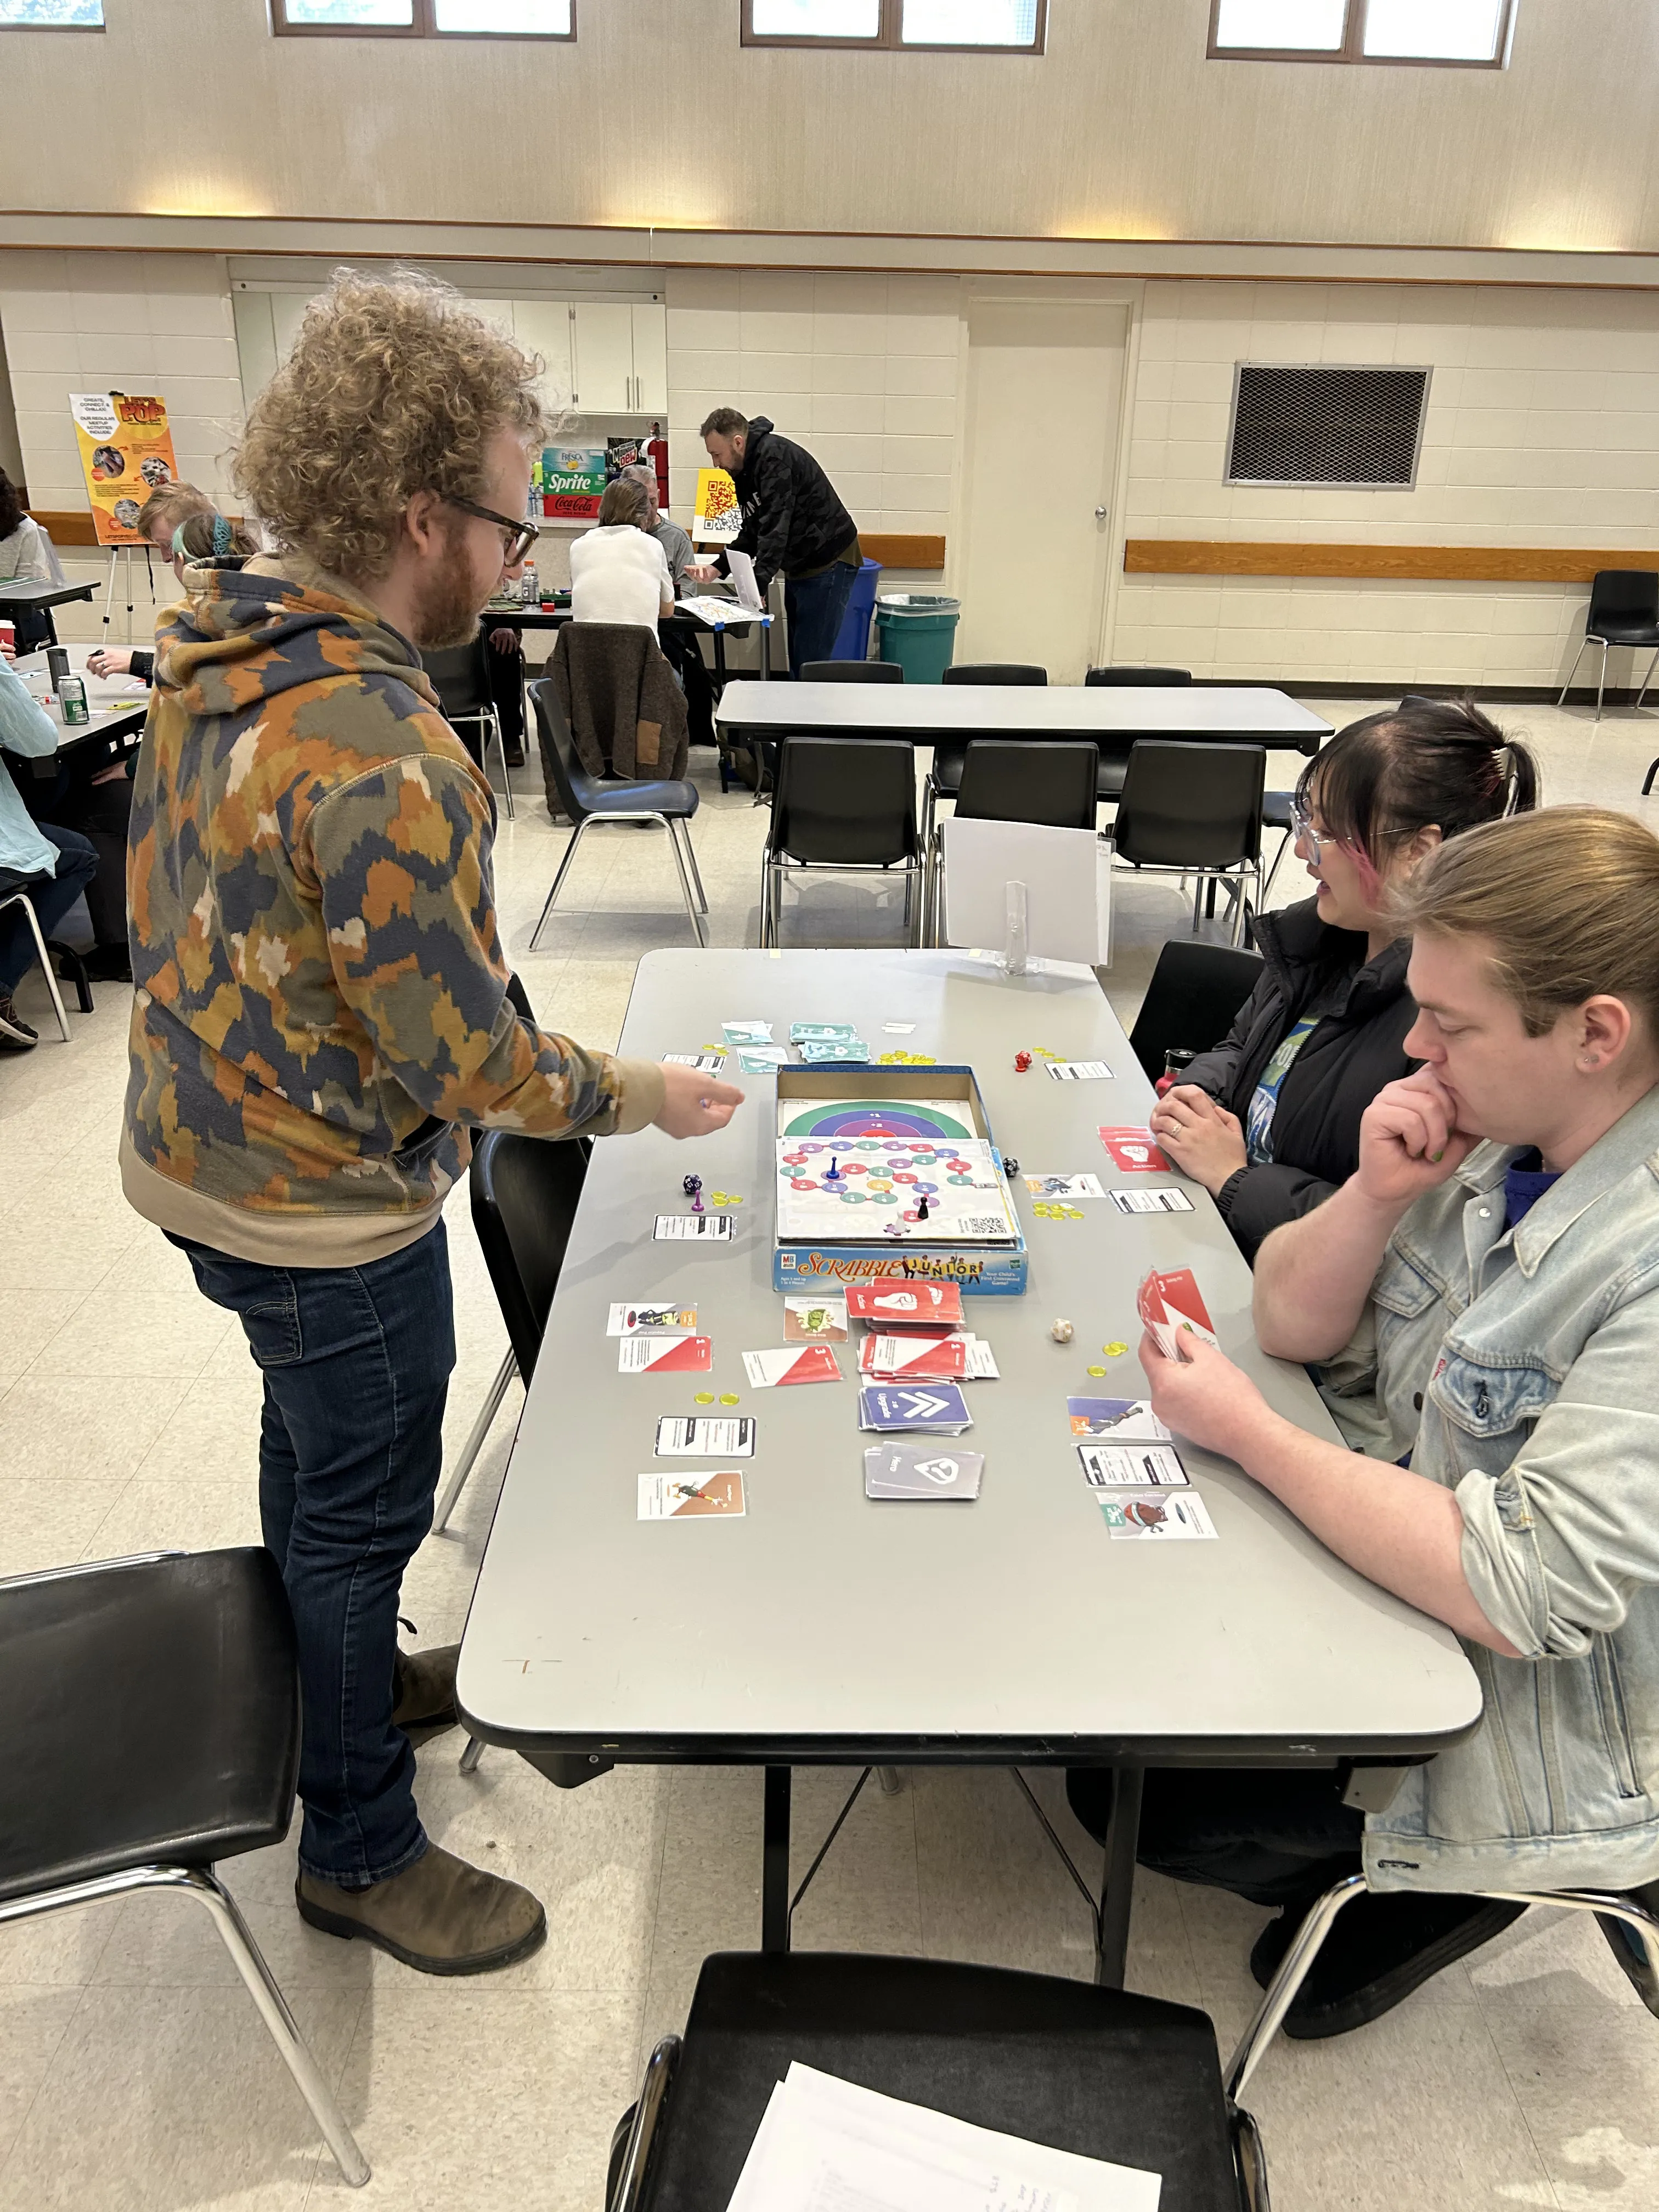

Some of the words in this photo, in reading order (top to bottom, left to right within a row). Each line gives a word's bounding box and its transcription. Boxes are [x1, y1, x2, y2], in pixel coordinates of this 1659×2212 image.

[124, 396, 156, 405] LET'S
[119, 403, 166, 422] POP
[561, 452, 584, 461] FRESCA
[549, 473, 591, 492] Sprite
[523, 586, 529, 596] G
[797, 1252, 902, 1282] SCRABBLE
[911, 1259, 978, 1276] JUNIOR
[1158, 1280, 1166, 1292] 3
[877, 1393, 893, 1419] Upgrade
[888, 1455, 902, 1472] Hero
